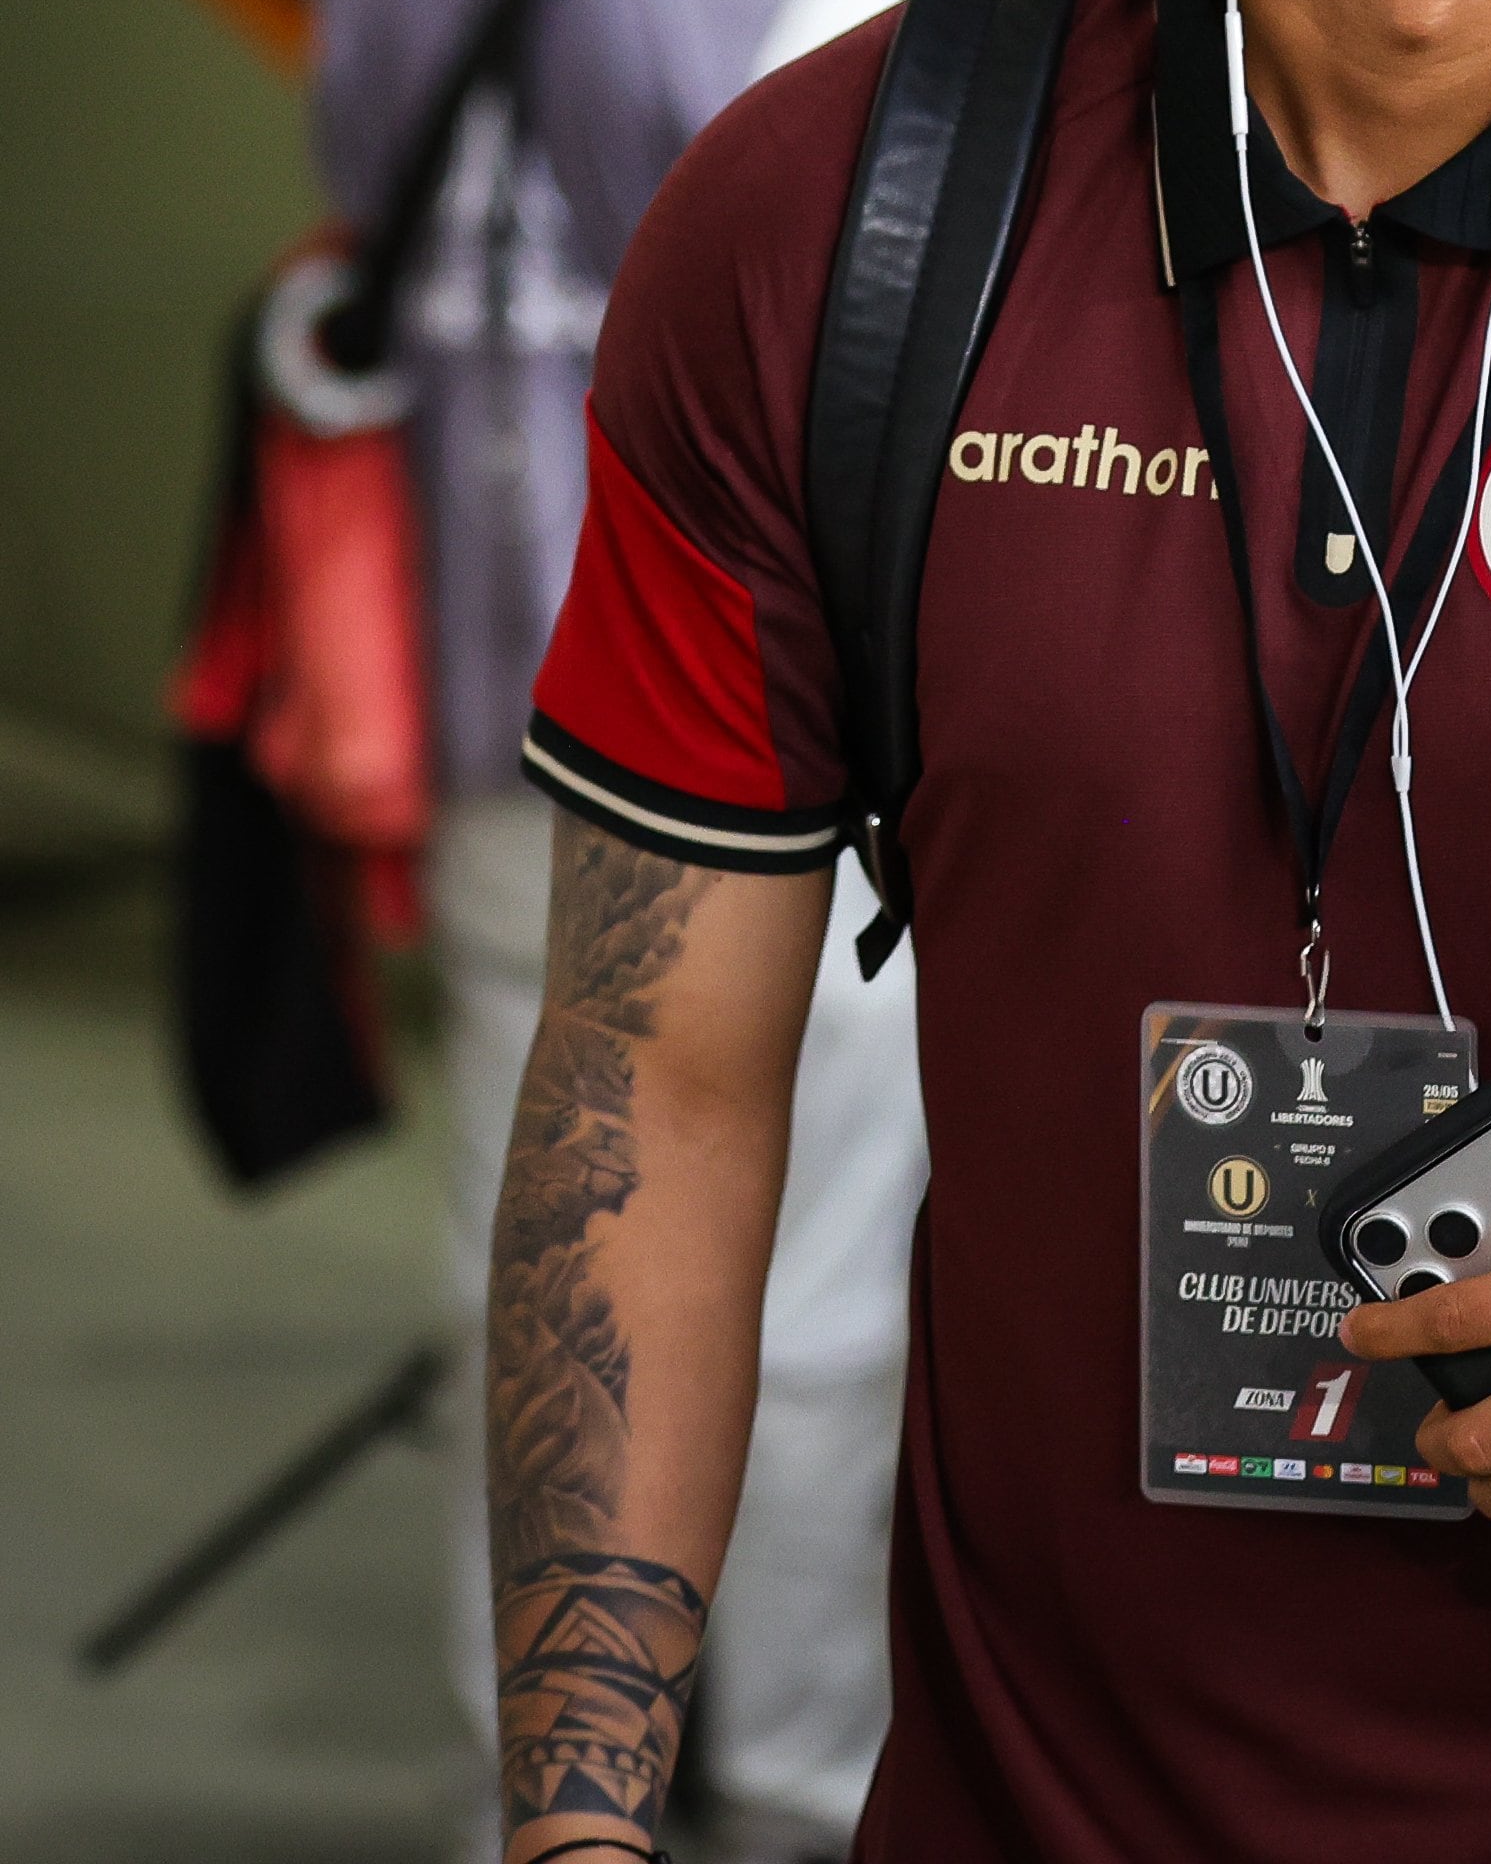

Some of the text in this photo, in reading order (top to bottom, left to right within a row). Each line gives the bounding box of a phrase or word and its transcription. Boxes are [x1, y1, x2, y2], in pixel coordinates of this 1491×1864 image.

[948, 423, 1220, 500] arathon
[1270, 1111, 1354, 1127] LIBERTADORES
[1223, 1168, 1254, 1211] U
[1179, 1272, 1245, 1303] CLUB
[1222, 1305, 1257, 1334] DE
[1244, 1369, 1352, 1437] ZONA 1
